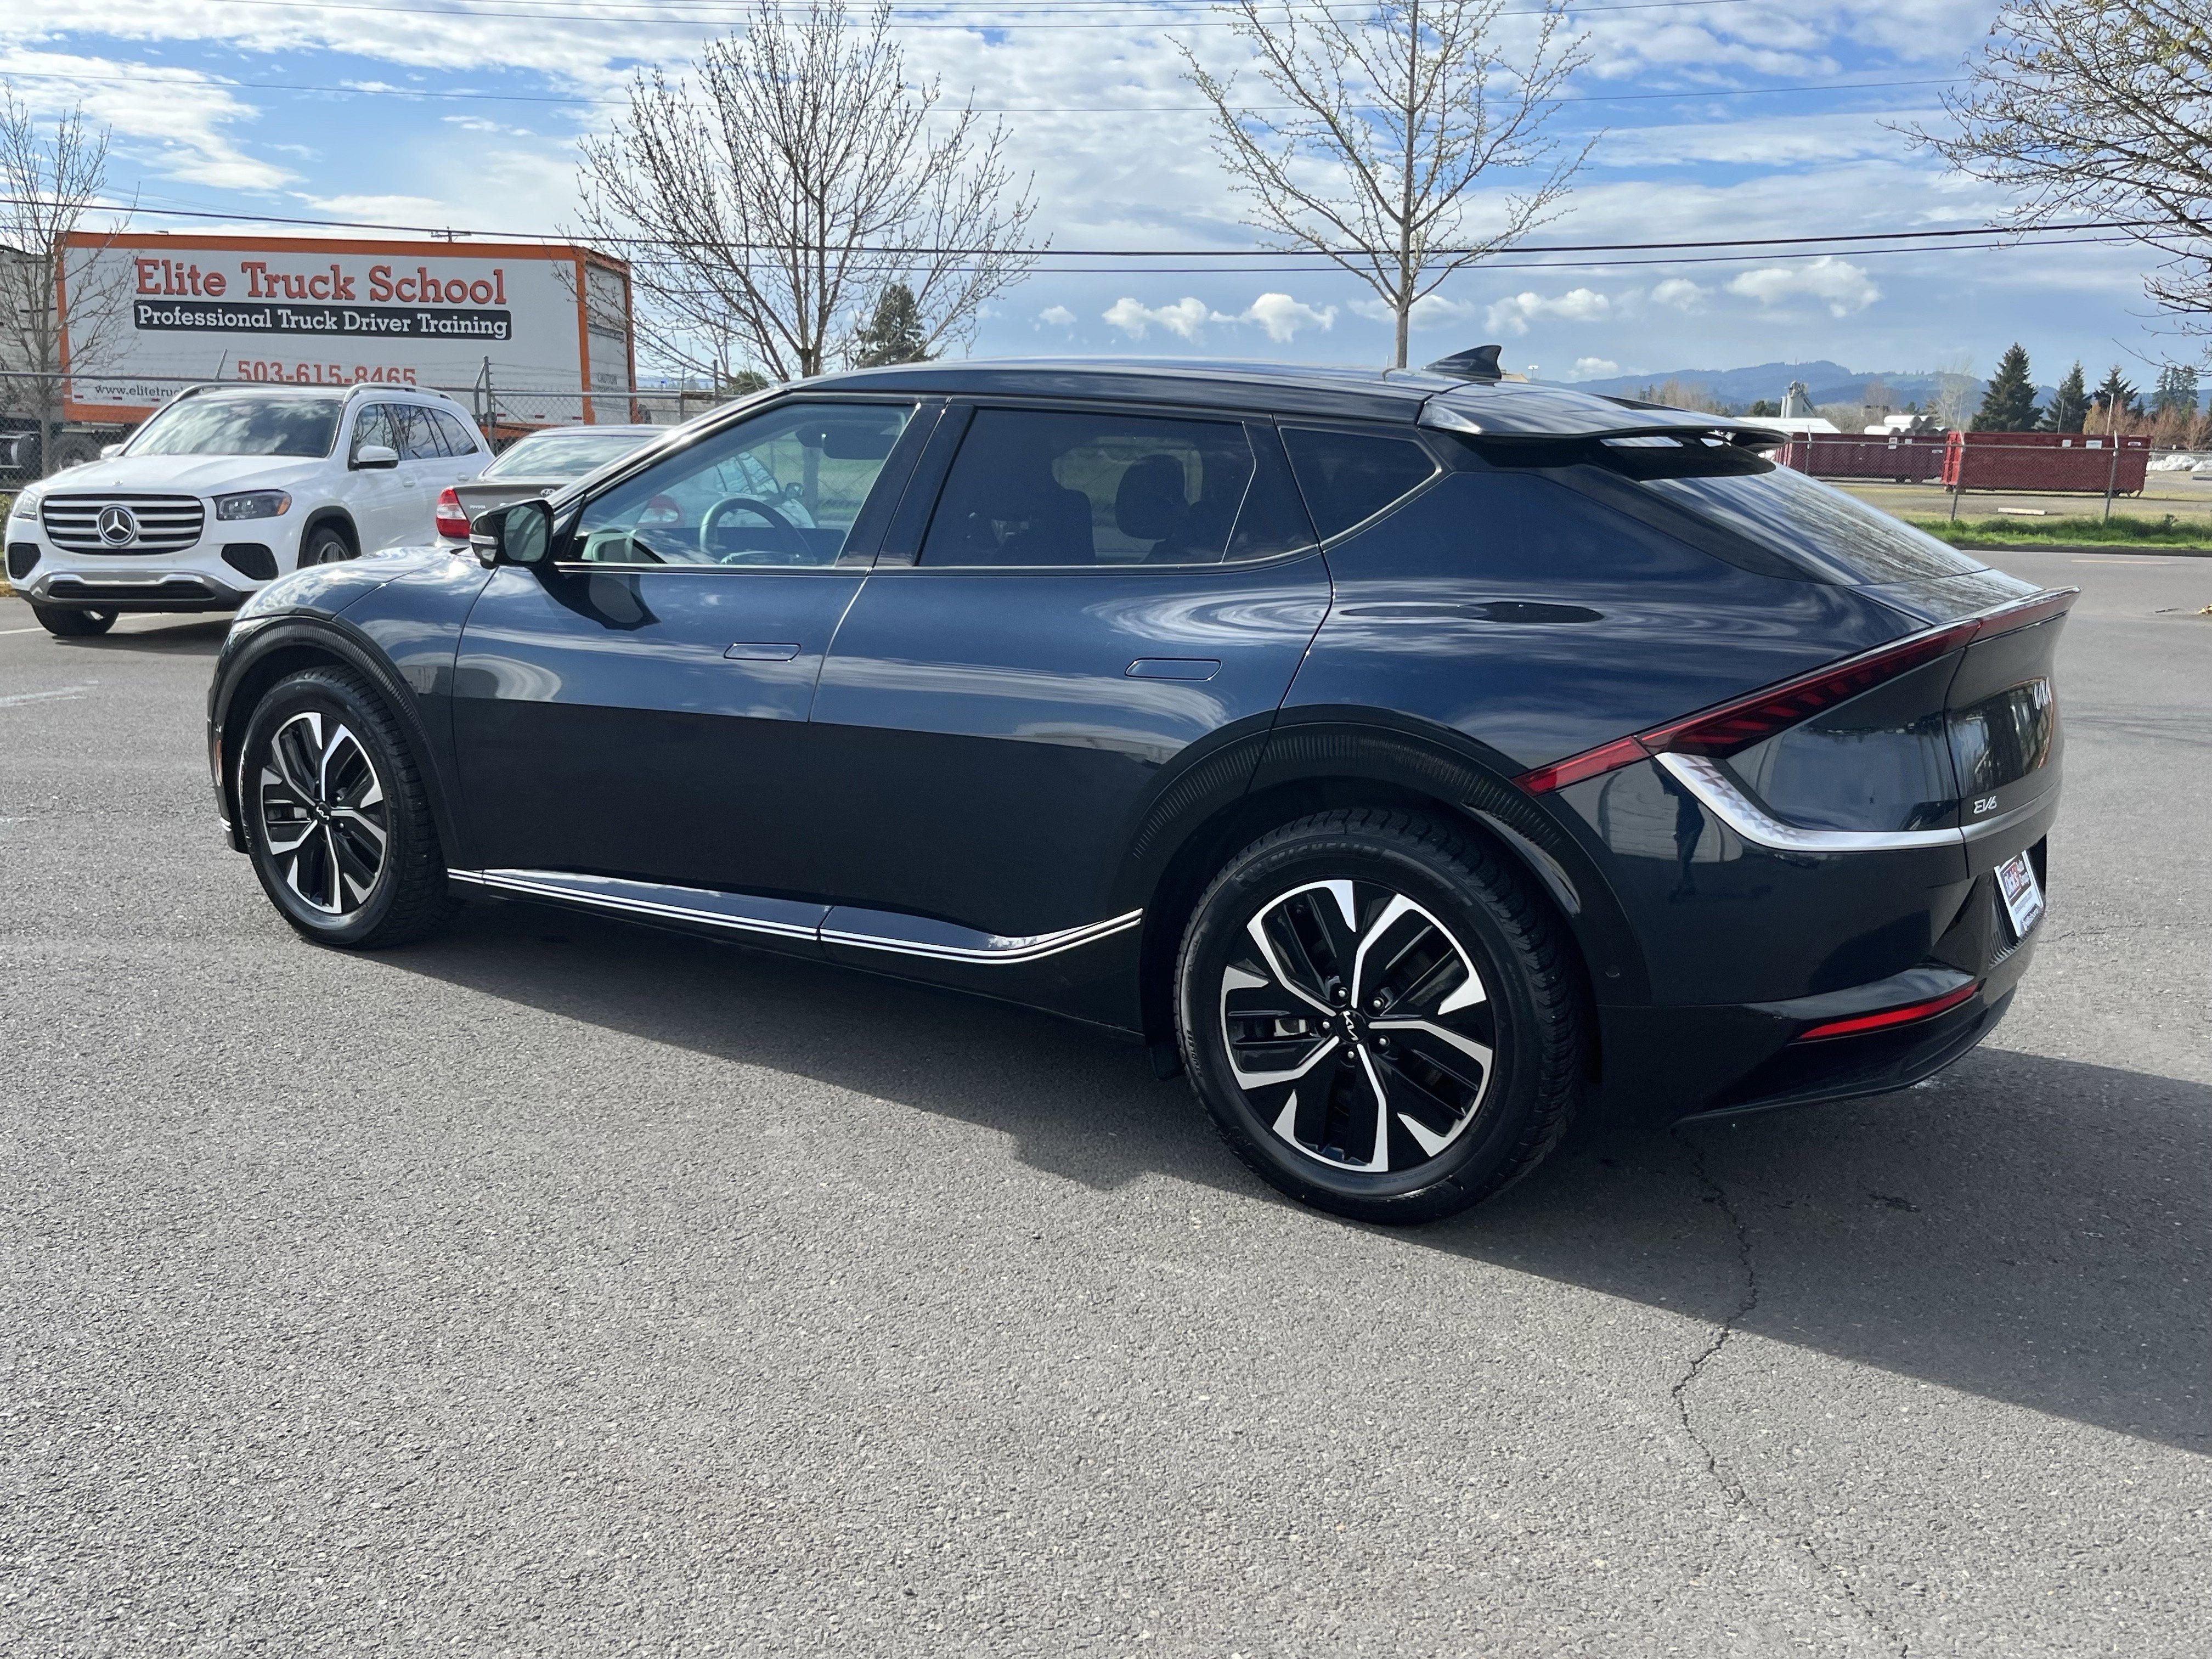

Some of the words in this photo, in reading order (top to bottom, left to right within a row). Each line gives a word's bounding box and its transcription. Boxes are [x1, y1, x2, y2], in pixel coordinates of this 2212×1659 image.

[134, 258, 227, 296] Elite
[241, 262, 356, 301] Truck
[369, 265, 507, 304] School
[138, 305, 273, 328] Professional
[278, 309, 337, 330] Truck
[343, 311, 411, 332] Driver
[417, 313, 508, 340] Training
[238, 360, 416, 385] 503-615-8465
[1973, 795, 1997, 814] EV6
